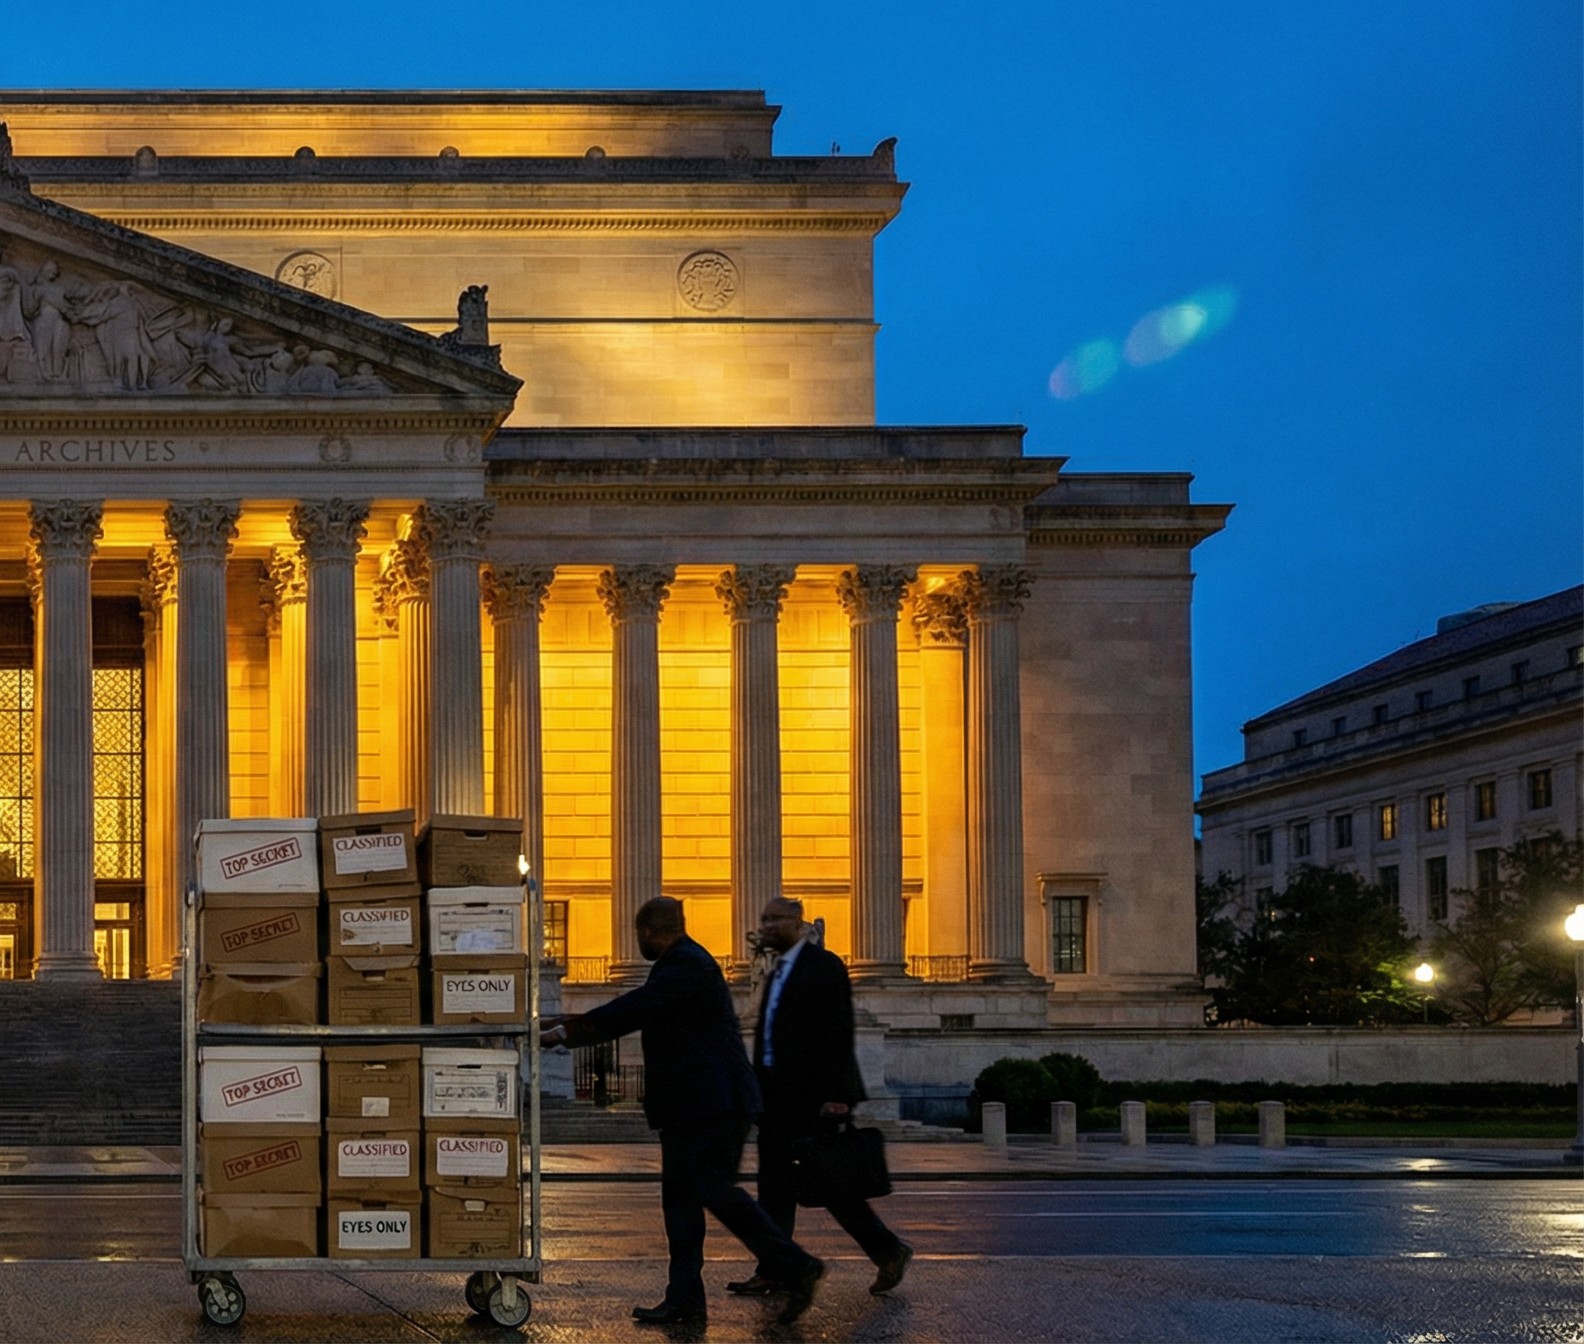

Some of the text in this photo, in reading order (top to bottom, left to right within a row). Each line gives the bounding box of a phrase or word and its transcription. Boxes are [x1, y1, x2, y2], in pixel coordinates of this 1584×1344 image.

[15, 439, 176, 462] ARCHIVES
[225, 857, 248, 874] TOP
[225, 931, 248, 948] TOP
[446, 979, 511, 992] EYES ONLY
[226, 1084, 251, 1101] TOP
[342, 1143, 407, 1156] CLASSIFIED
[227, 1160, 252, 1176] TOP
[342, 1220, 407, 1233] EYES ONLY
